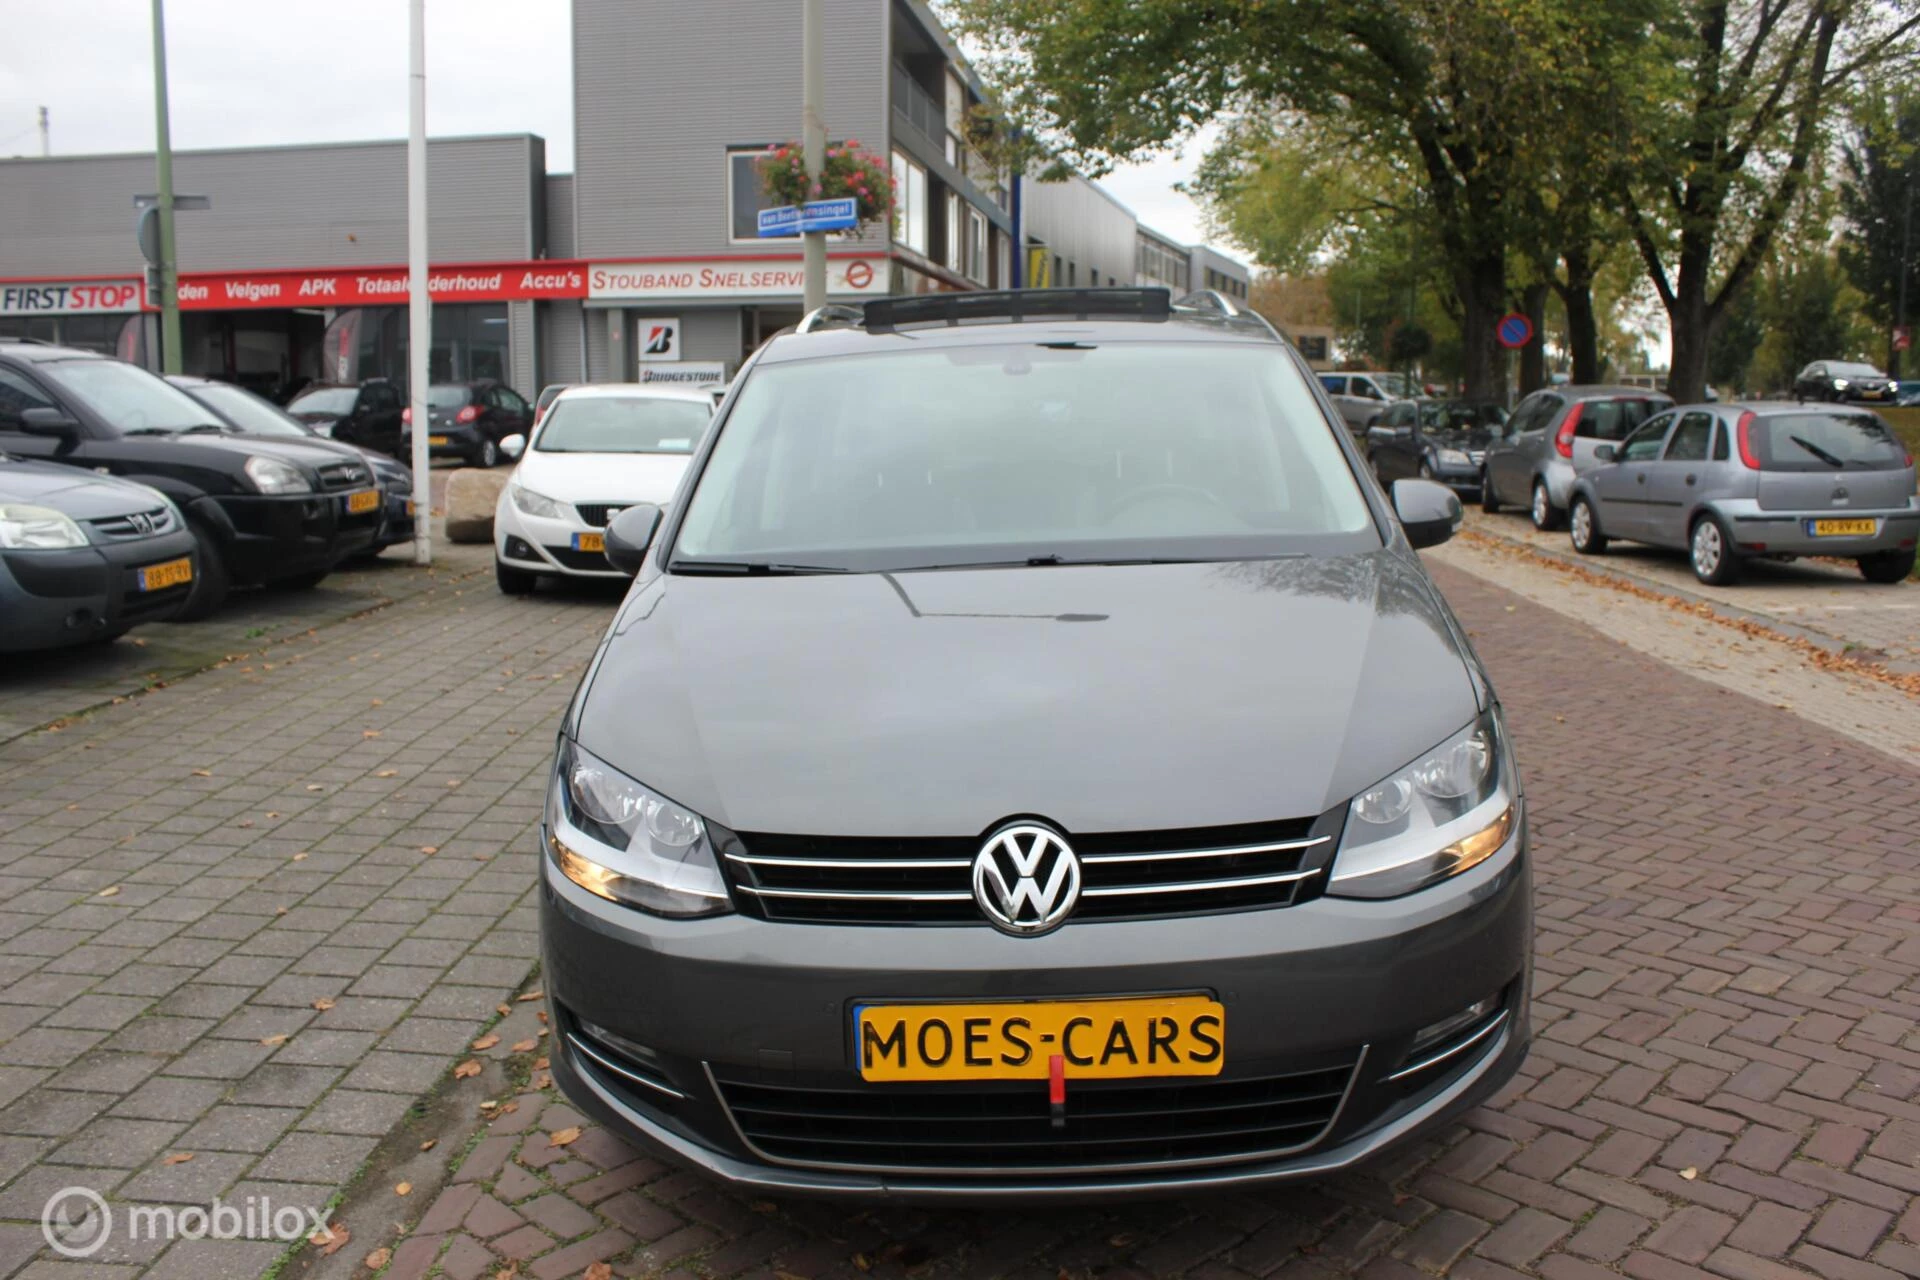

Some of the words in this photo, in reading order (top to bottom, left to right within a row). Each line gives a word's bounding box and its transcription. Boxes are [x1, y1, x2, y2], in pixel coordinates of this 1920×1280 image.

[778, 204, 850, 220] Beethensingel
[225, 281, 281, 301] Velgen
[299, 278, 337, 296] APK
[357, 273, 502, 294] Totaalderhoud
[520, 271, 582, 289] Accu's
[699, 268, 806, 288] SNELSERVI
[862, 1014, 1222, 1069] MOES-CARS
